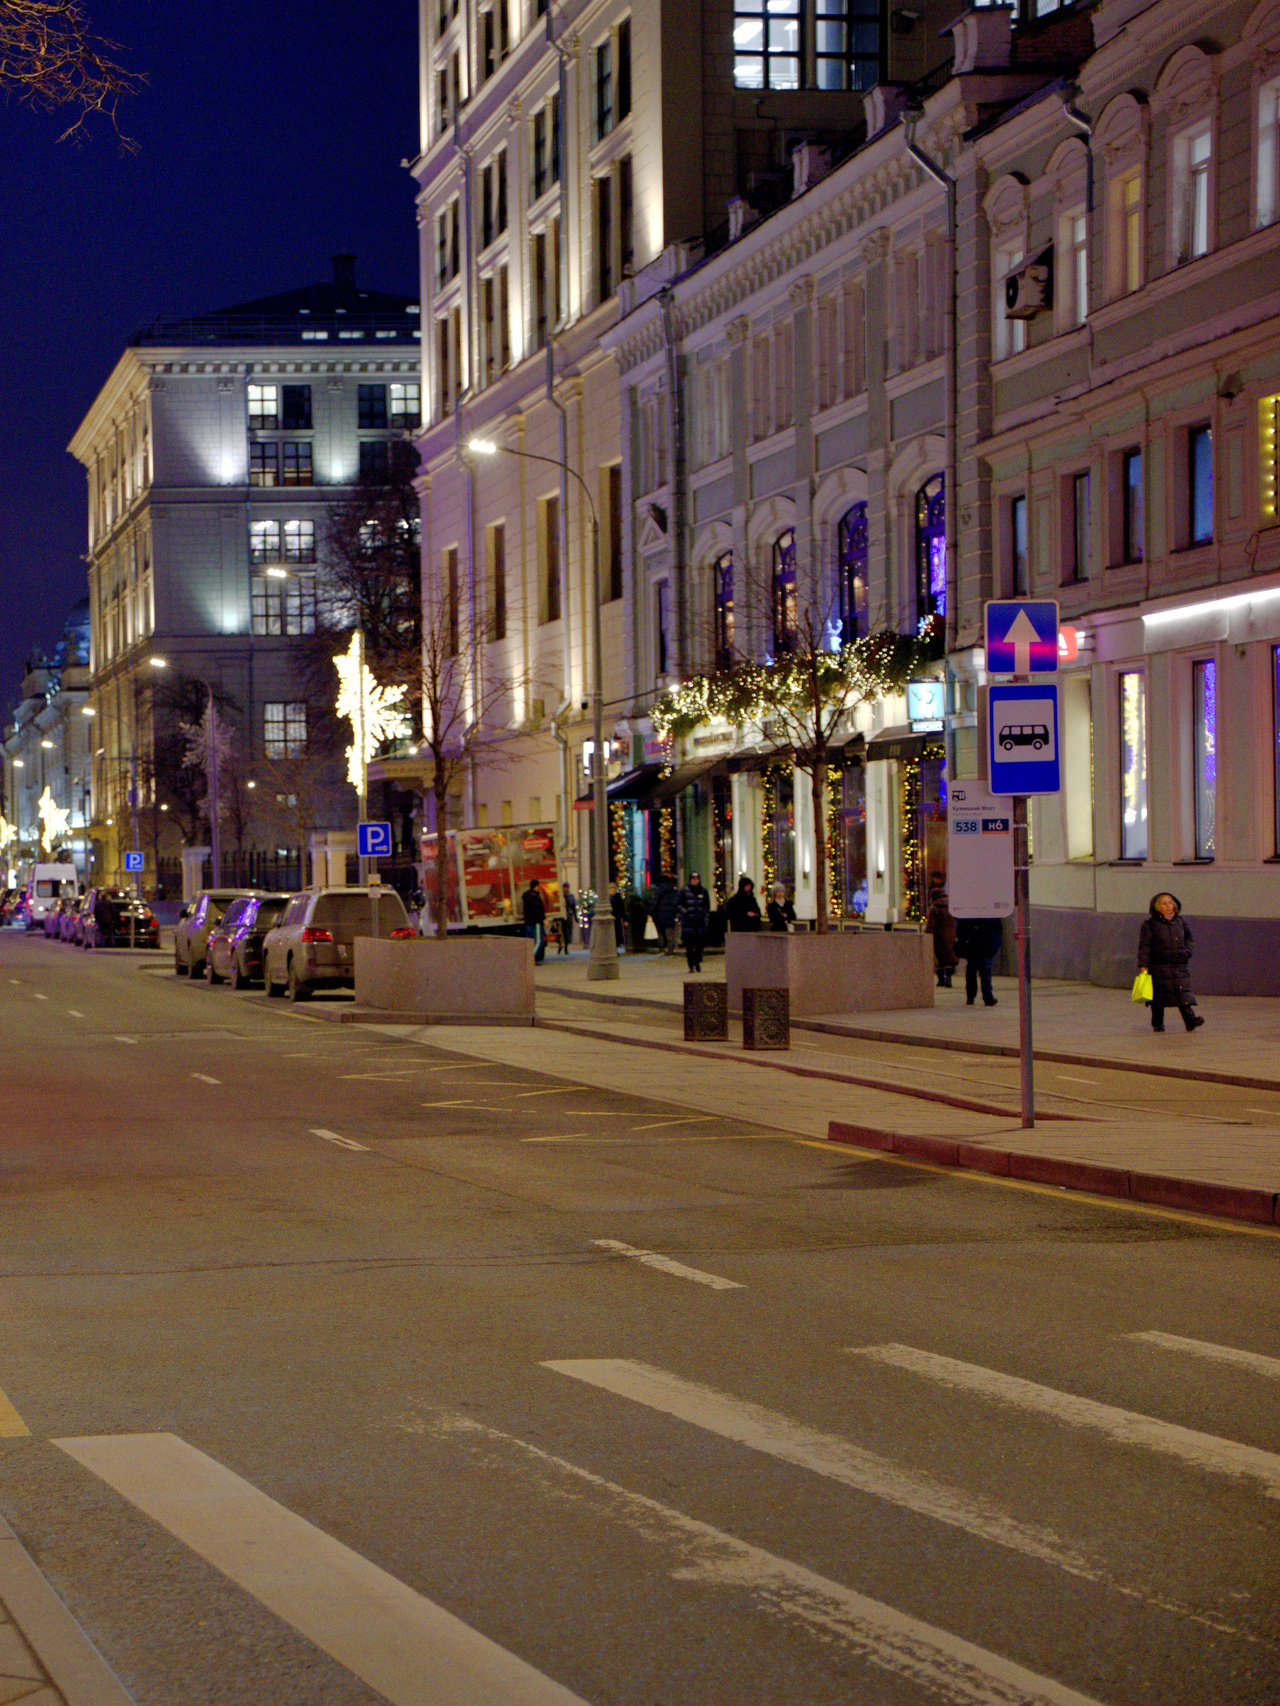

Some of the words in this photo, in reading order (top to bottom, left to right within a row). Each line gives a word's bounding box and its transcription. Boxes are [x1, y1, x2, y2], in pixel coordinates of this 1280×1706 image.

[956, 822, 977, 832] 538
[367, 827, 385, 853] P
[130, 854, 141, 869] P
